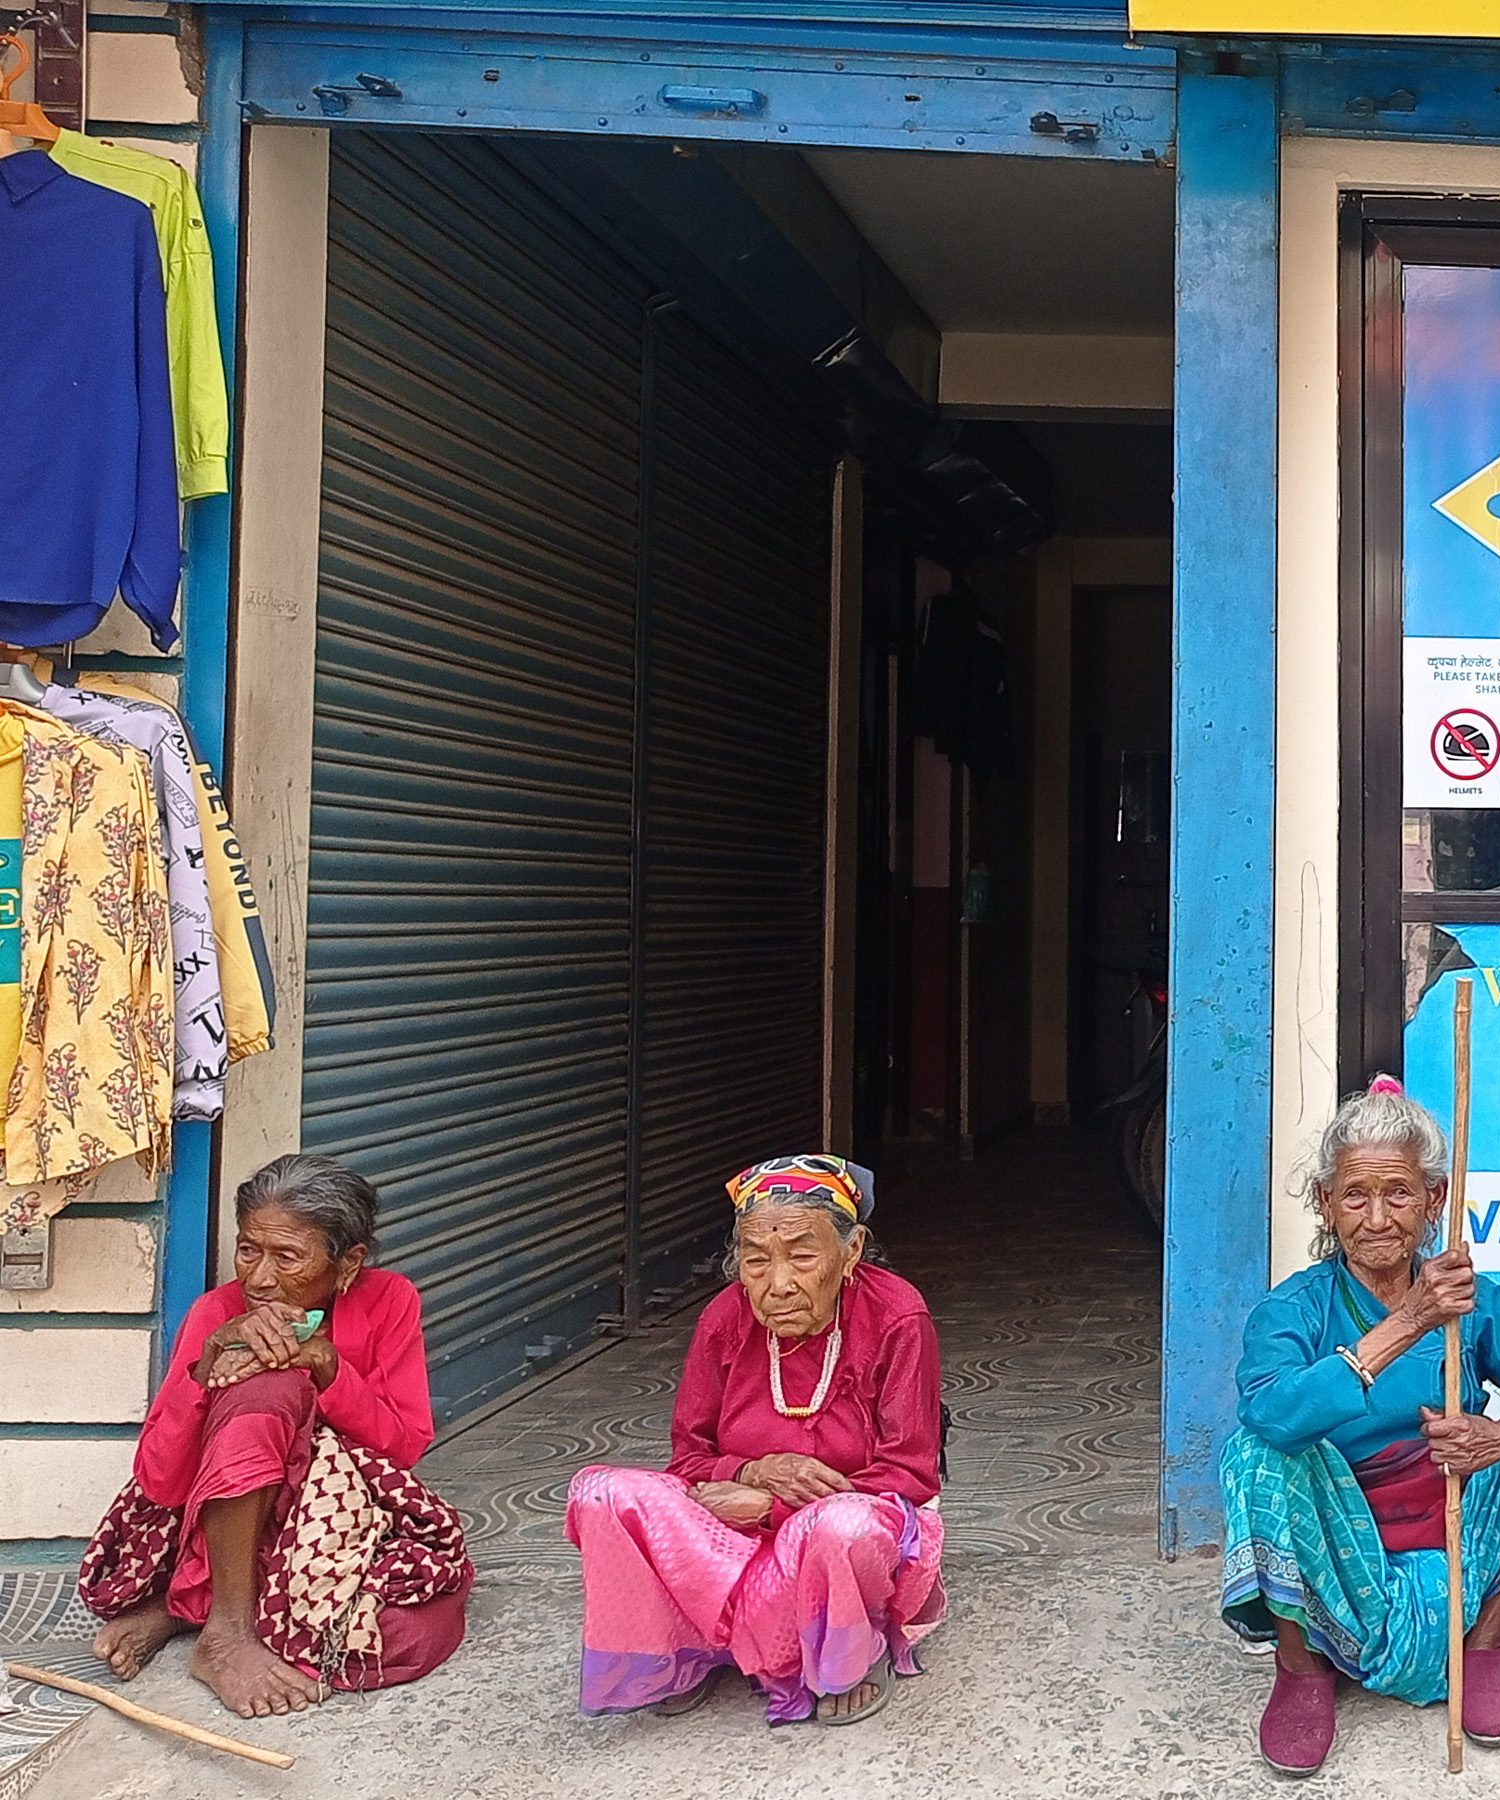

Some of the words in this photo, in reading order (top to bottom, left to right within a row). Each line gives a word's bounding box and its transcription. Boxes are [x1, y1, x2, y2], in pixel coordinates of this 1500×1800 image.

[1433, 671, 1472, 681] PLEASE
[1449, 787, 1483, 795] HELMETS
[200, 770, 258, 909] BEYOND
